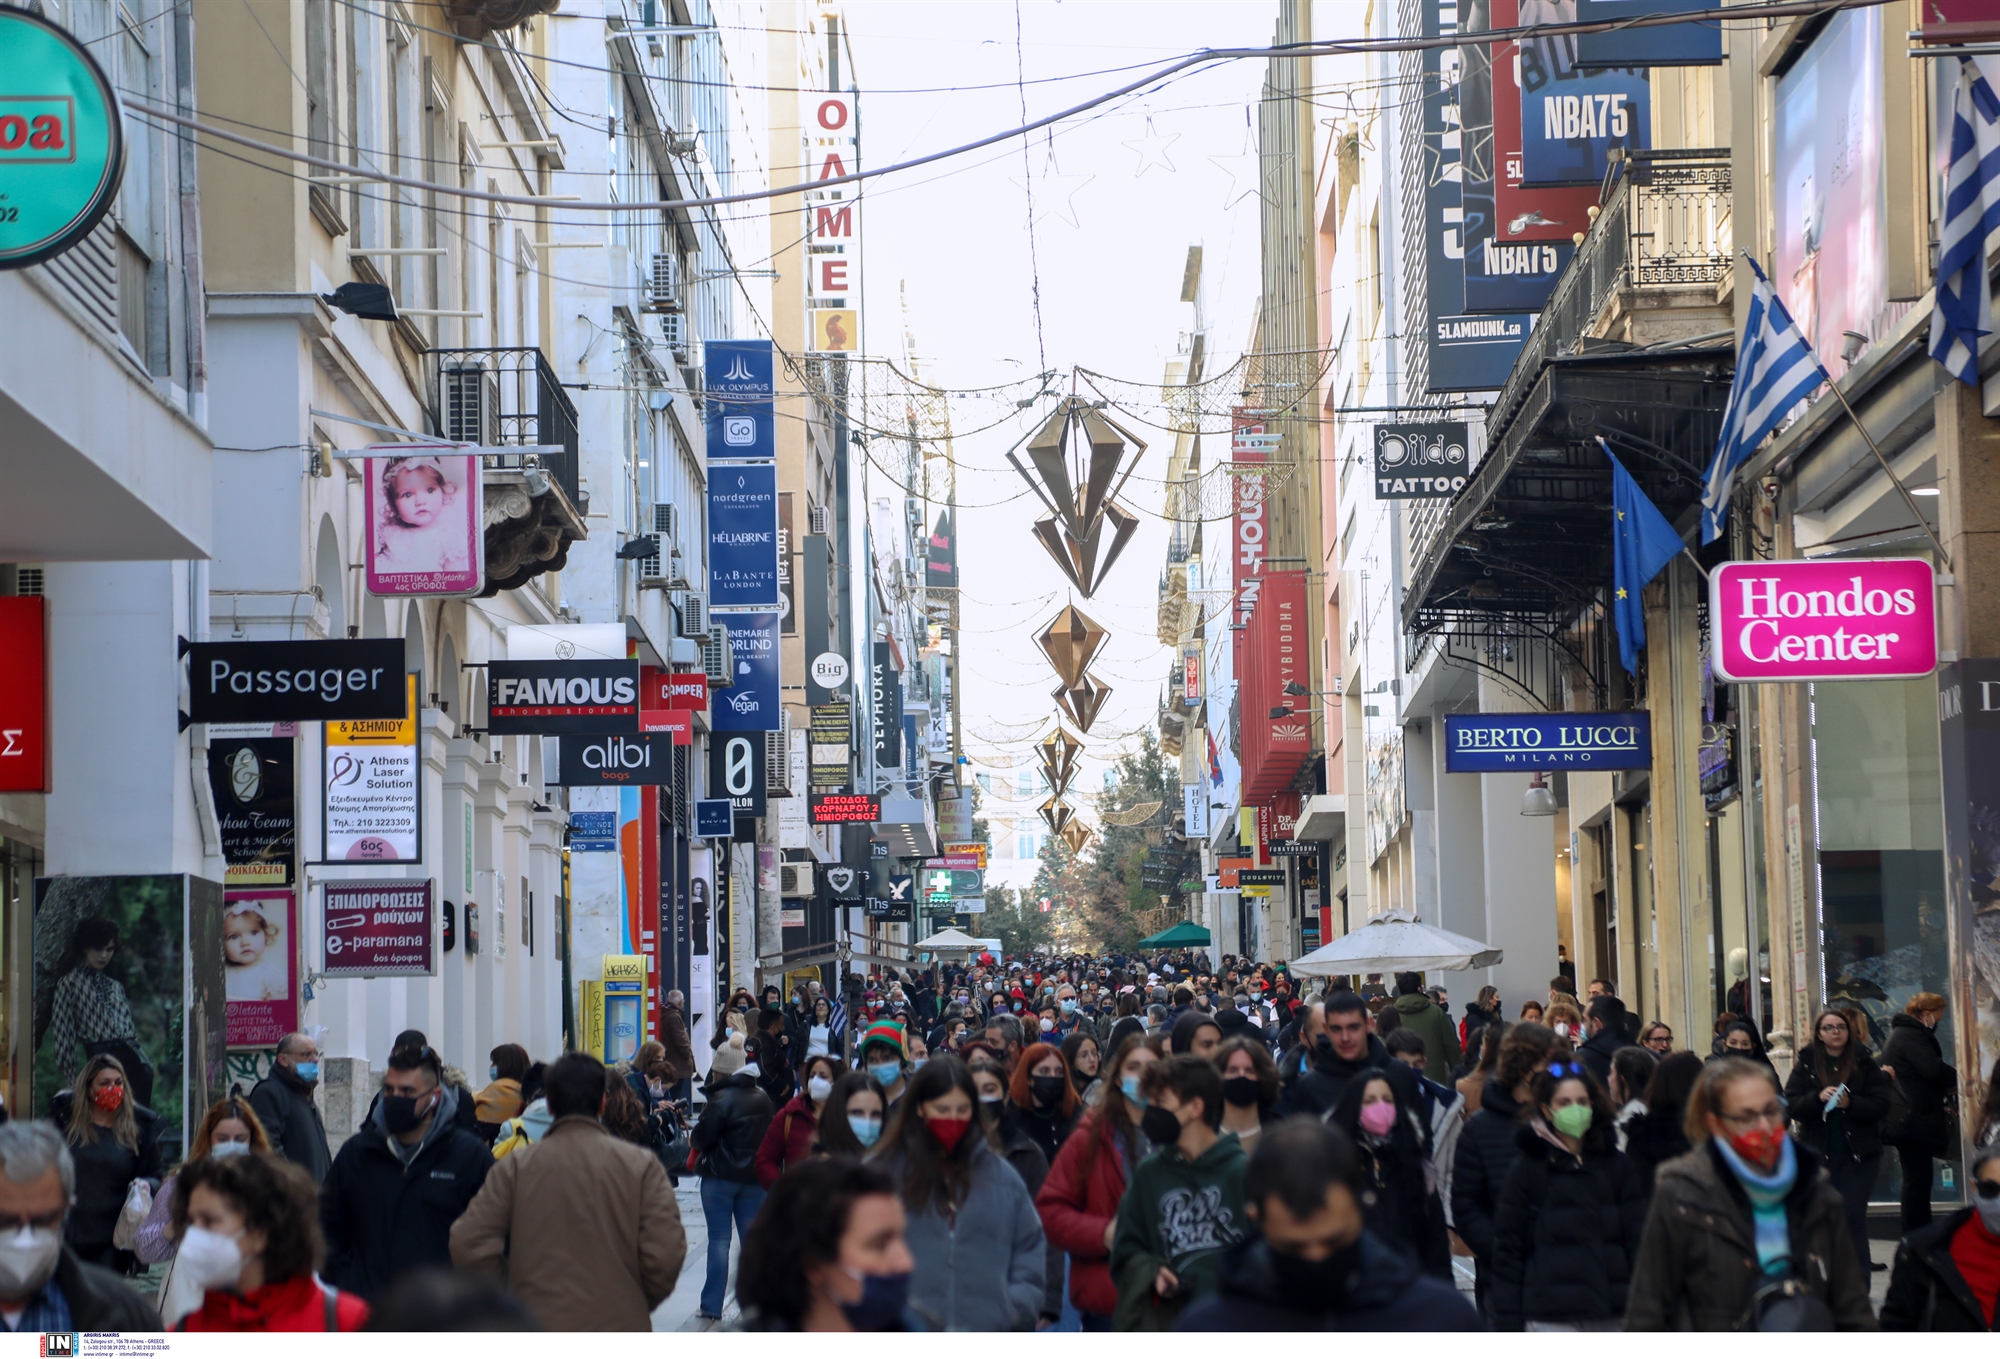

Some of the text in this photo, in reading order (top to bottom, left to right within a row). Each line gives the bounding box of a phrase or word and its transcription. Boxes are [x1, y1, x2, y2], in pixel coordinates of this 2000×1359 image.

[1544, 94, 1629, 139] NBA75
[1484, 238, 1558, 275] NBA75
[1438, 320, 1521, 340] SLAMDUNK.GR
[728, 383, 769, 391] OLYMPUS
[730, 423, 750, 435] Go
[1379, 429, 1465, 472] Dildo
[1379, 476, 1466, 493] TATTOO
[713, 493, 771, 503] nordgreen
[712, 531, 771, 543] HÉLIABRINE
[378, 574, 429, 583] ΒΑΠΤΙΣΤΙΚΑ
[411, 582, 447, 590] ΟΡΟΦΟΣ
[1737, 576, 1916, 618] Hondos
[1740, 620, 1900, 663] Center
[816, 663, 843, 676] Big
[211, 660, 384, 702] Passager
[498, 677, 635, 705] FAMOUS
[661, 684, 703, 699] CAMPER
[726, 691, 759, 714] Vegan
[873, 663, 885, 749] SEPHORA
[498, 706, 629, 715] shoes stores
[340, 720, 403, 732] & ΑΣΗΜΙΟΥ
[1457, 726, 1638, 747] BERTO LUCCI
[582, 736, 650, 769] alibi
[1505, 753, 1592, 762] MILANO
[370, 757, 409, 765] Athens
[374, 768, 405, 776] Laser
[602, 771, 630, 781] bags
[367, 779, 413, 788] Solution
[728, 798, 753, 807] ALON
[823, 796, 868, 805] ΕΙΣΟΔΟΣ
[328, 804, 415, 813] Μόνιμης Αποτρίχωσης
[814, 804, 878, 813] ΚΟΡΝΑΡΟΥ 2
[1192, 789, 1200, 830] HOTEL
[250, 812, 292, 828] Team
[333, 819, 354, 827] Τηλ.:
[816, 813, 876, 821] ΗΜΙΟΡΟΦΟΣ
[242, 837, 249, 845] &
[252, 837, 279, 845] Make
[282, 837, 295, 847] up
[361, 840, 383, 852] 6ος
[949, 844, 982, 852] ΑΓΟΡΑ
[233, 848, 264, 857] School
[870, 842, 888, 855] hs
[926, 858, 945, 867] pink
[327, 892, 425, 910] ΕΠΙΔΙΟΡΘΩΣΕΙΣ
[866, 897, 888, 910] Ths
[373, 909, 424, 925] ρούχων
[326, 935, 423, 955] e-paramana
[391, 953, 423, 964] όροφος
[227, 1025, 284, 1034] ΟΜΠΟΝΙΕΡΕΣ
